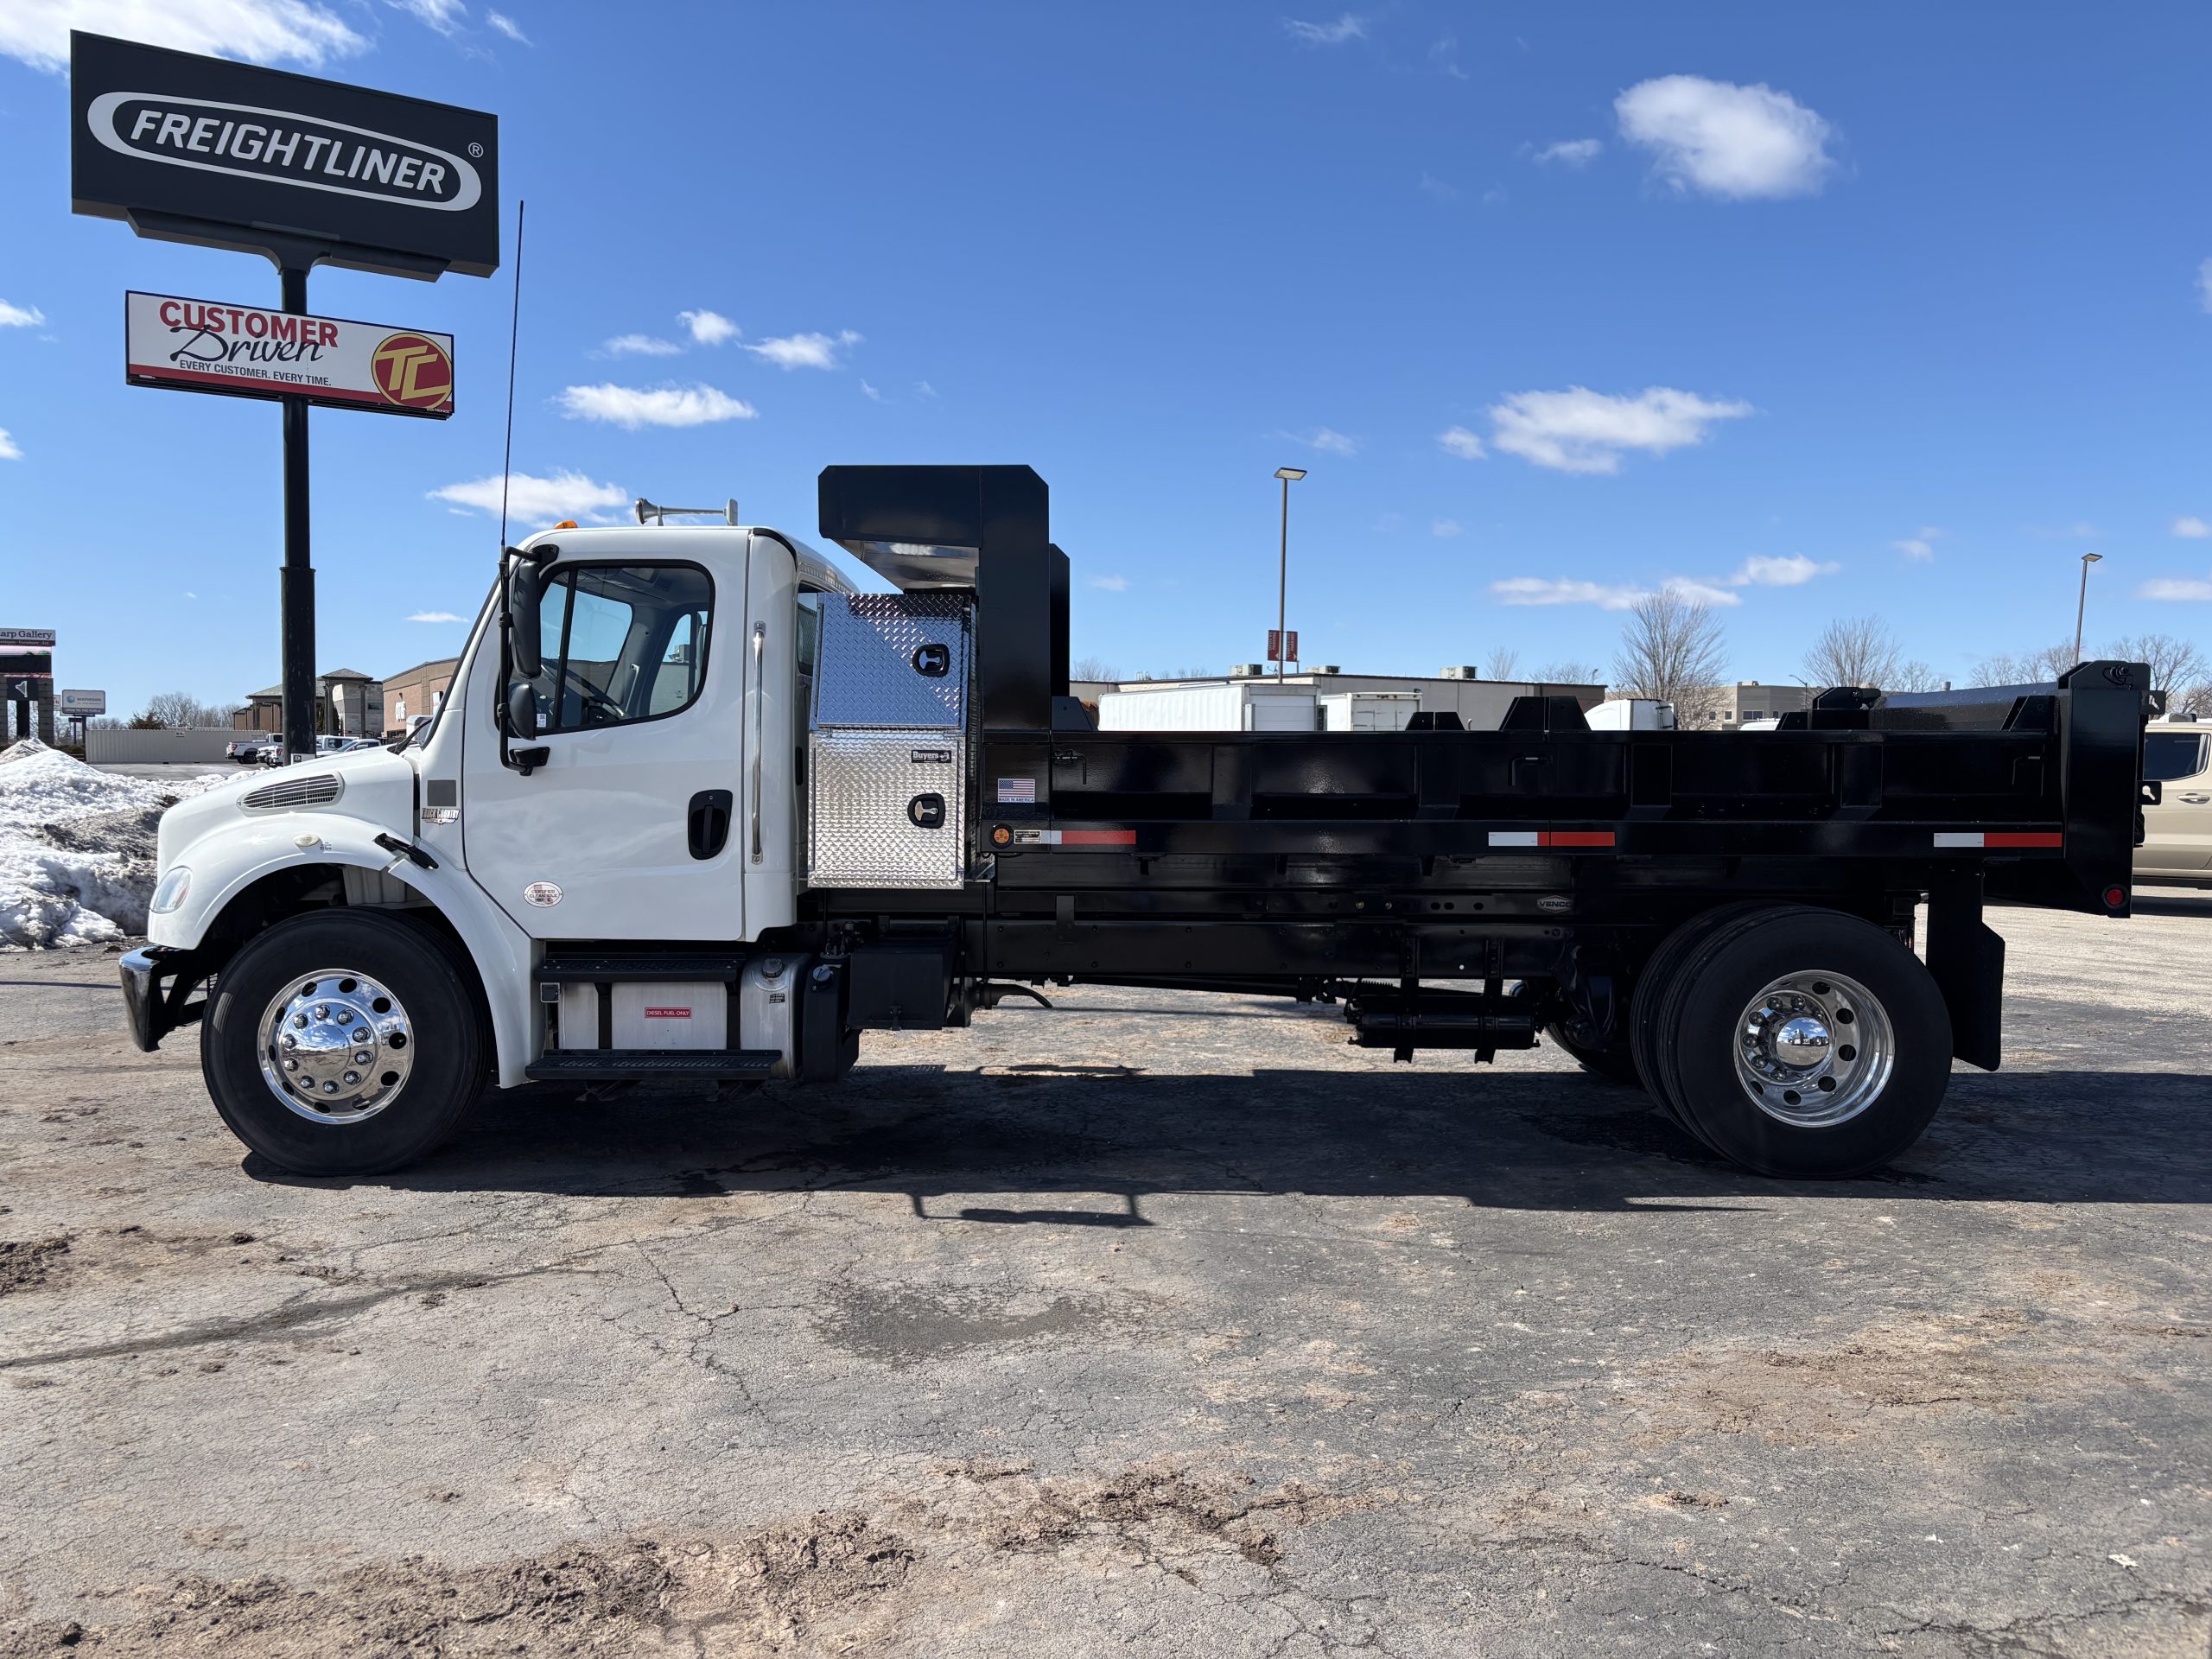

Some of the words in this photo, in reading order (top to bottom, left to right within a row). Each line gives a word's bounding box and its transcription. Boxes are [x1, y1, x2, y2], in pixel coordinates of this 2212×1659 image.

[130, 109, 446, 194] FREIGHTLINER
[159, 301, 339, 348] CUSTOMER
[169, 323, 324, 362] Driven
[180, 359, 212, 372] EVERY
[213, 364, 270, 379] CUSTOMER.
[273, 371, 303, 383] EVERY
[306, 375, 332, 386] TIME.
[18, 630, 53, 639] Gallery
[912, 751, 939, 760] Buyers
